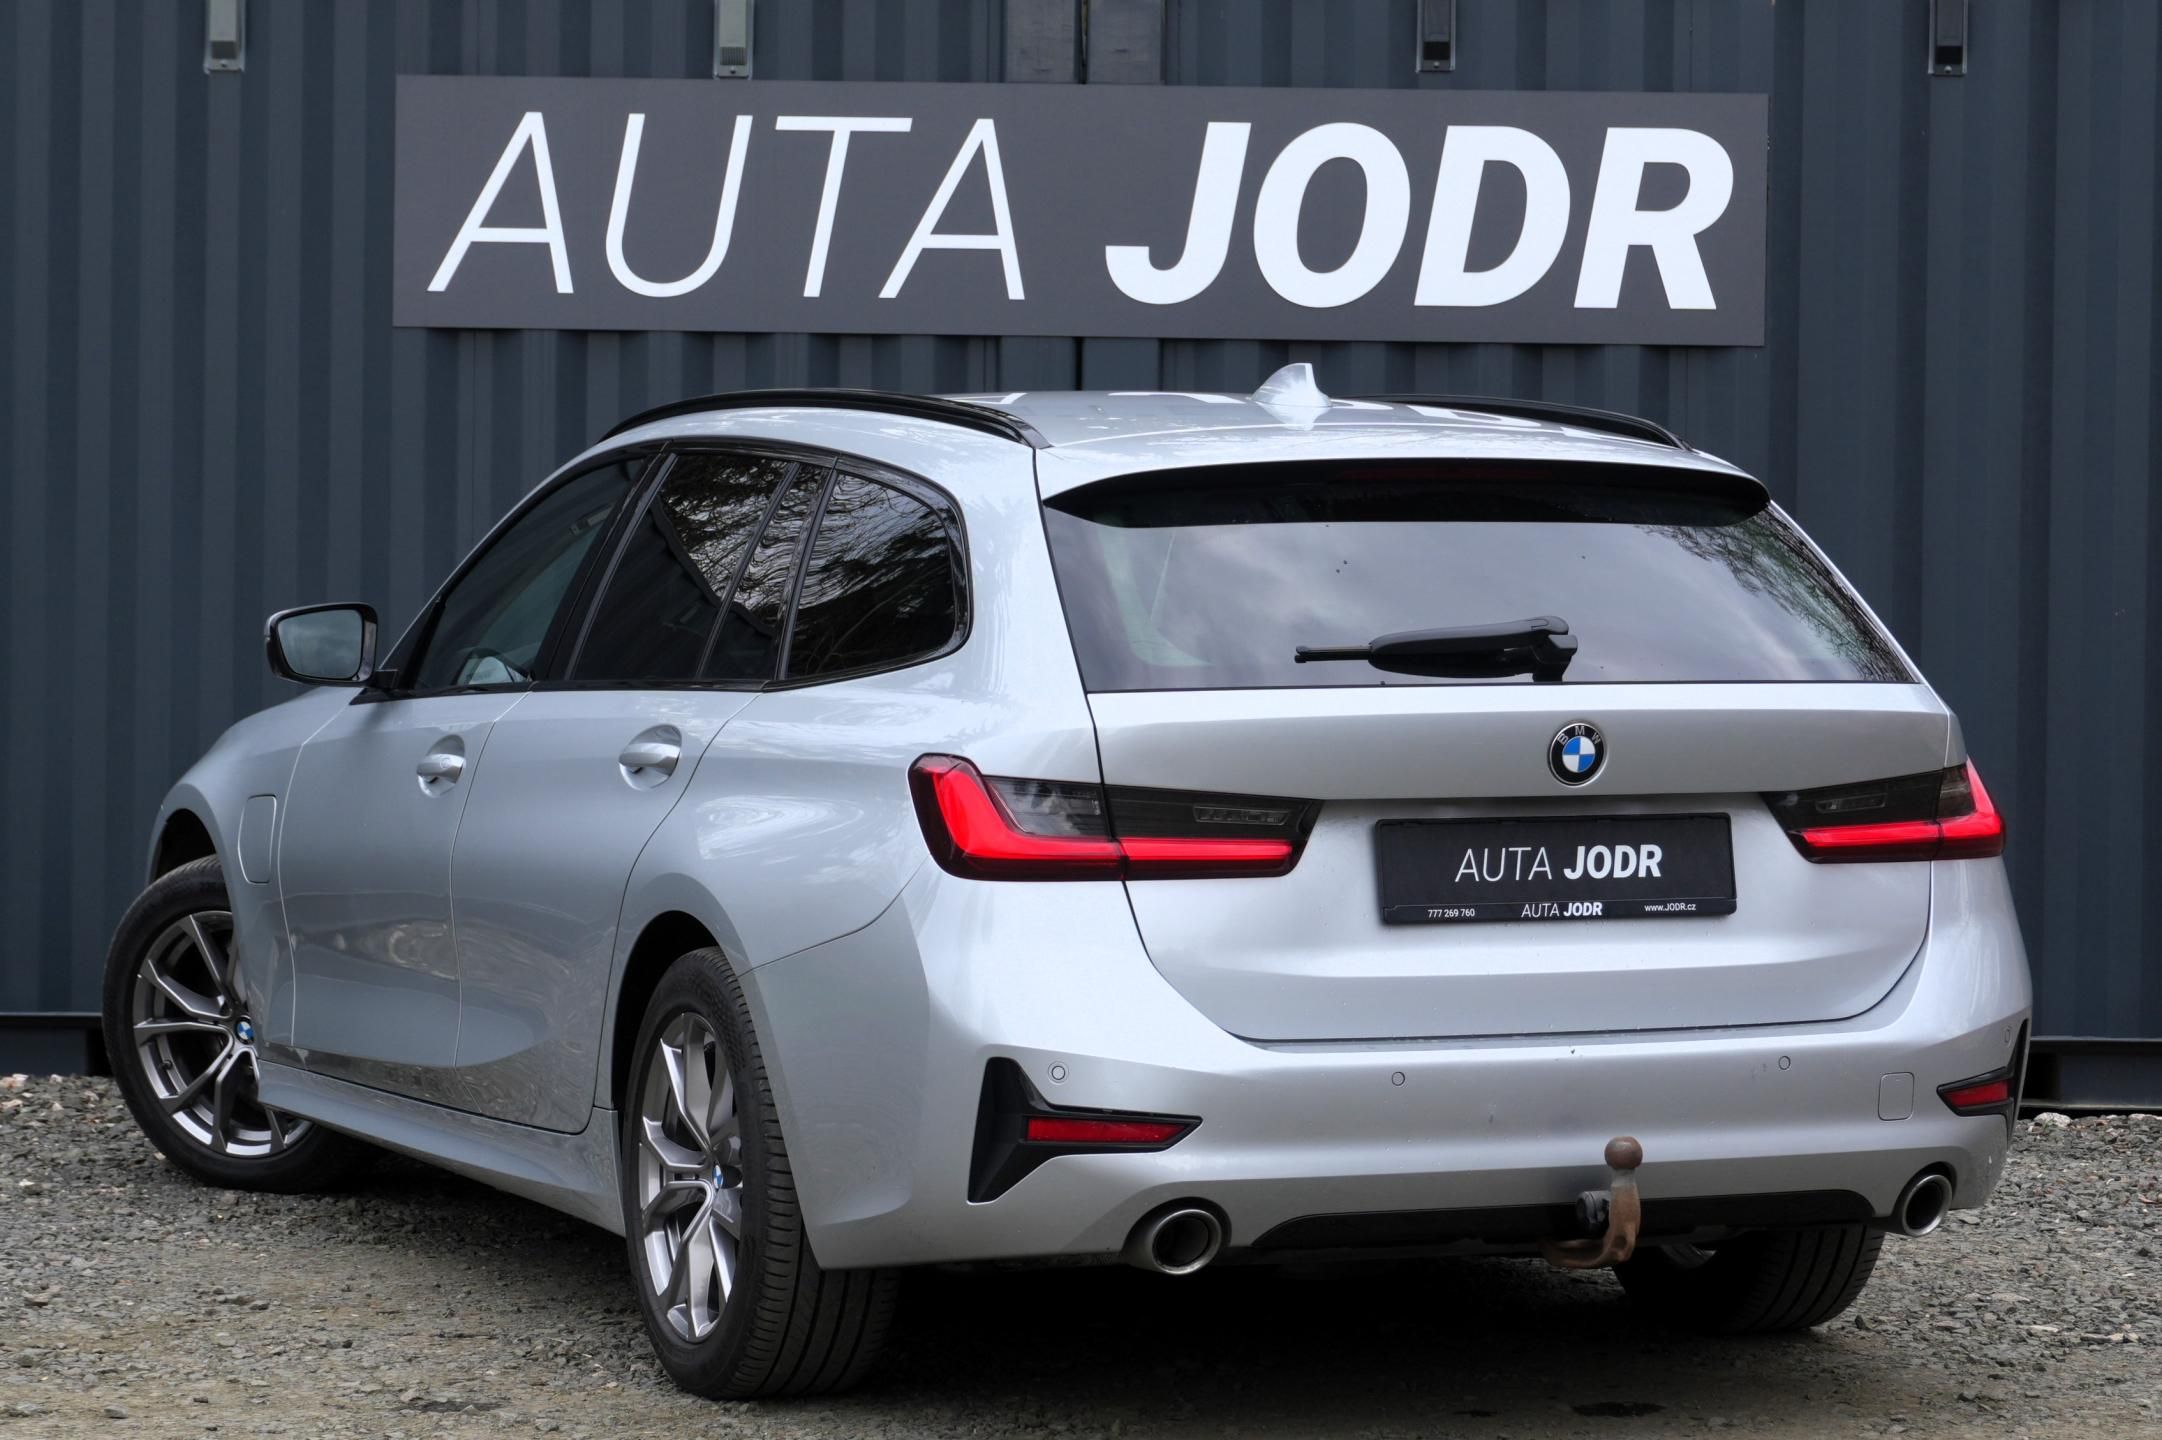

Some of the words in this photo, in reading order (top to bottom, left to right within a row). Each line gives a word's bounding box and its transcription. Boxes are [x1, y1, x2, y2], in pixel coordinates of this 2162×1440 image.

[427, 111, 1026, 300] AUTA
[1105, 121, 1734, 310] JODR
[1557, 725, 1601, 746] BMW
[1454, 846, 1553, 883] AUTA
[1563, 844, 1663, 880] JODR
[1427, 908, 1443, 918] 777
[1443, 908, 1459, 918] 269
[1460, 907, 1476, 917] 760
[1521, 903, 1560, 918] AUTA
[1563, 902, 1603, 917] JODR
[1644, 902, 1697, 912] www.JODR.cz
